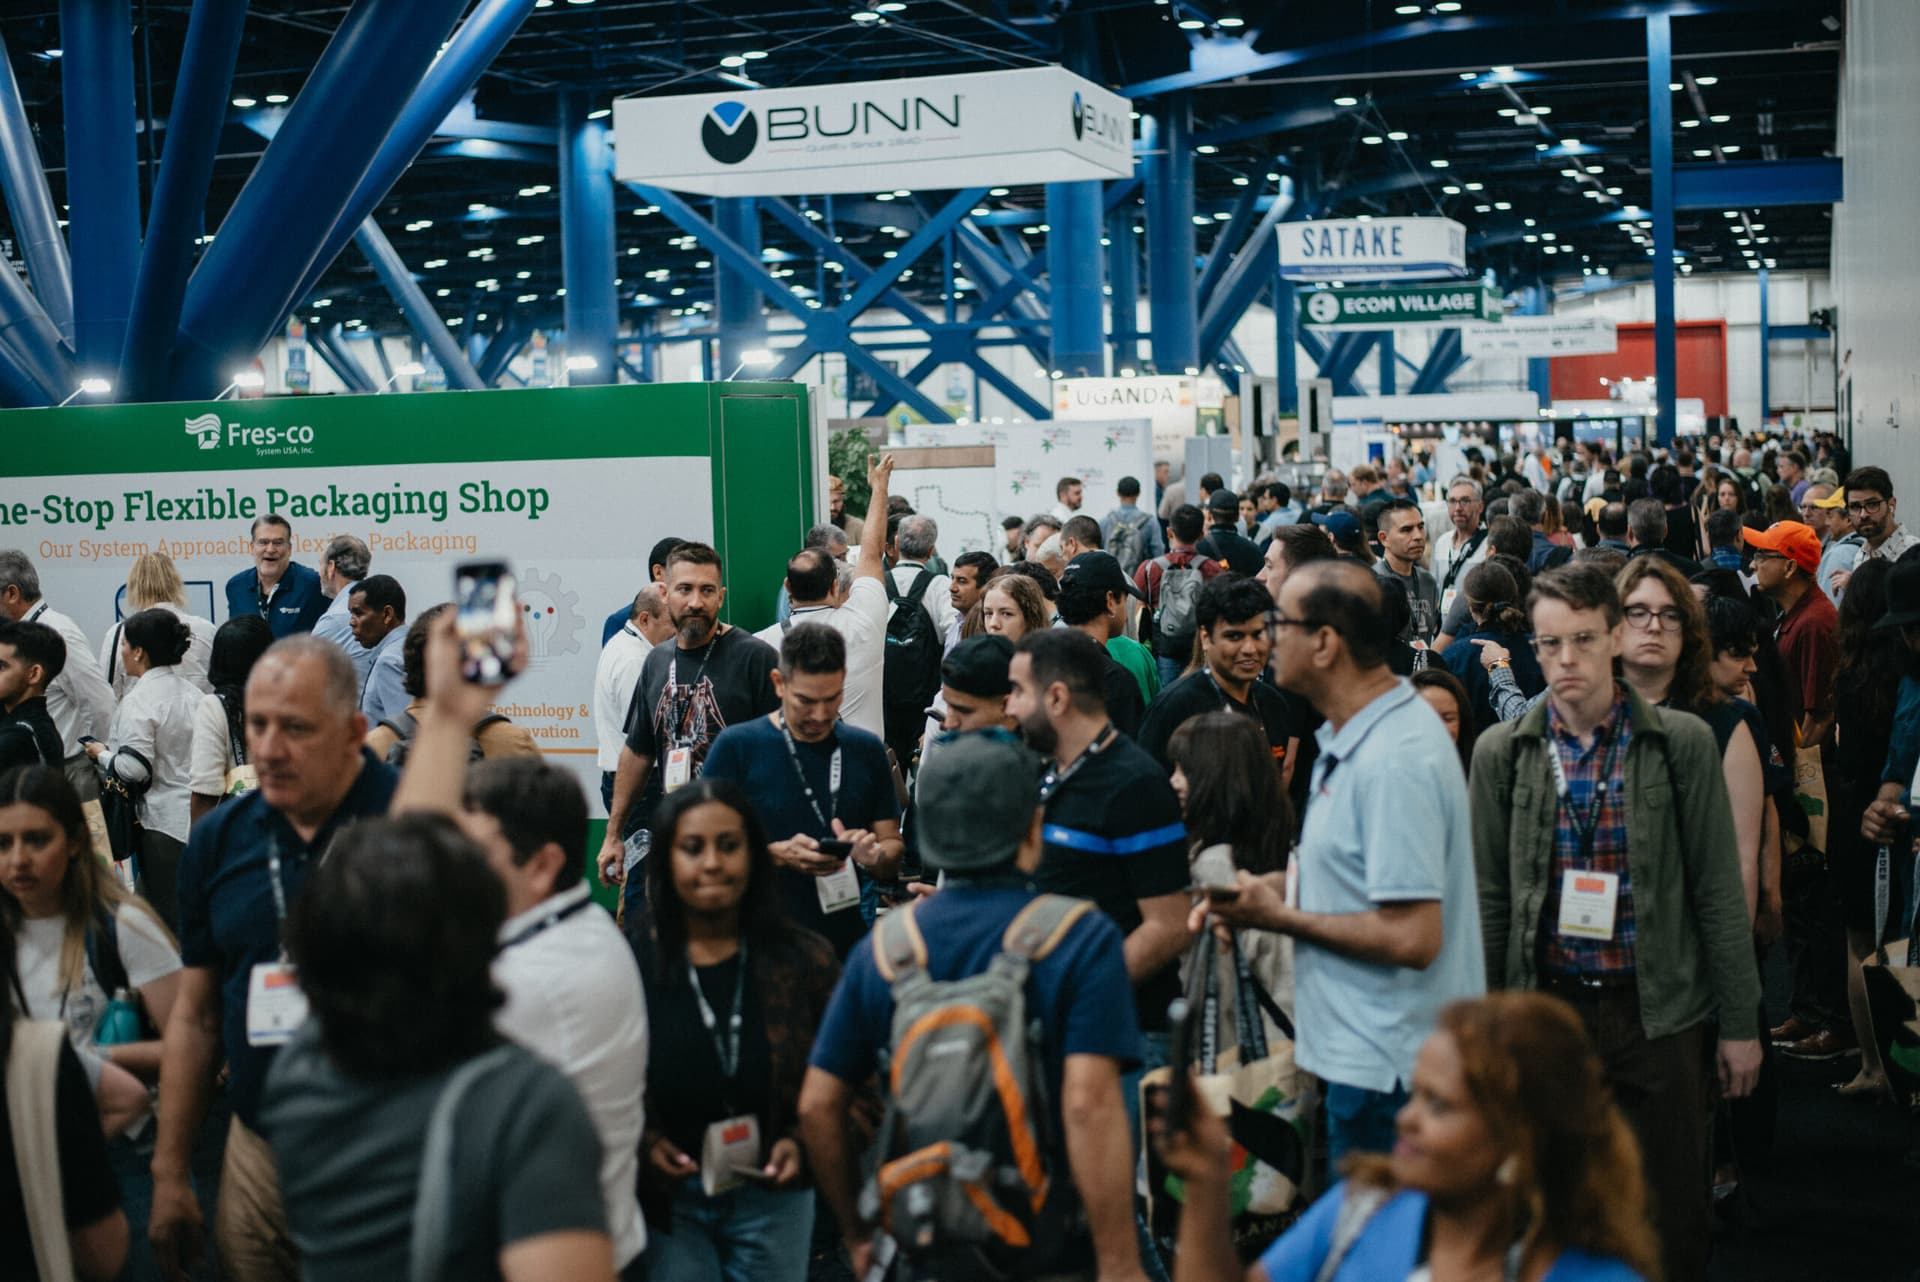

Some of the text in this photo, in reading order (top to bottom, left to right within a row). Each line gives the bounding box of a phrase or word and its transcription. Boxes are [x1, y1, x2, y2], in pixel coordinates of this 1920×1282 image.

[767, 94, 960, 141] BUNN
[1302, 226, 1403, 258] SATAKE
[1399, 293, 1476, 312] VILLAGE
[1077, 386, 1173, 406] UGANDA
[228, 423, 314, 446] Fres-co
[256, 448, 282, 456] System
[283, 447, 300, 455] USA,
[123, 488, 256, 521] Flexible
[266, 483, 448, 523] Packaging
[459, 480, 549, 519] Shop
[39, 541, 72, 558] Our
[80, 537, 149, 561] System
[157, 535, 251, 561] Approach
[369, 530, 478, 555] Packaging
[487, 703, 589, 720] Technology &
